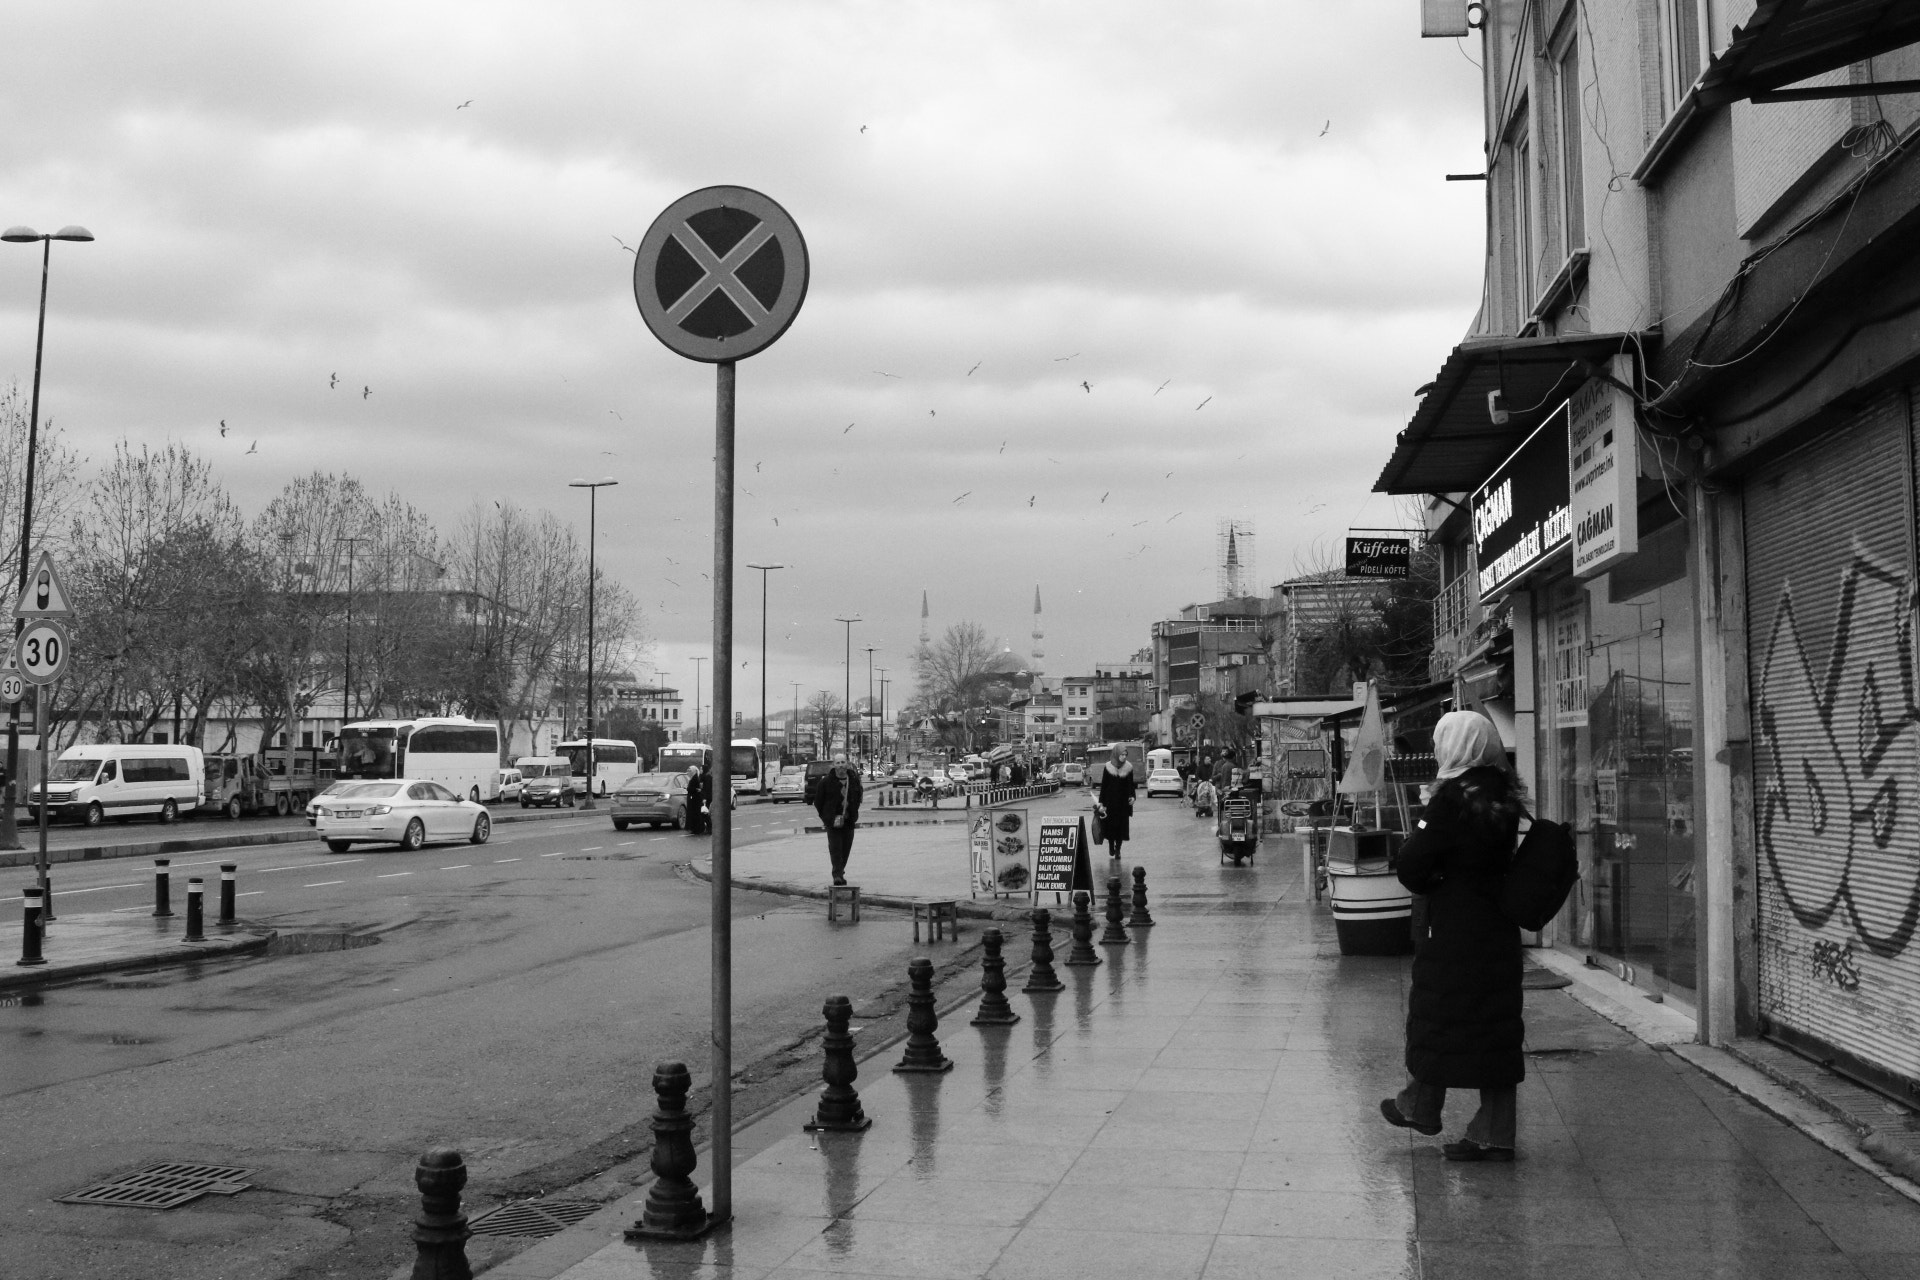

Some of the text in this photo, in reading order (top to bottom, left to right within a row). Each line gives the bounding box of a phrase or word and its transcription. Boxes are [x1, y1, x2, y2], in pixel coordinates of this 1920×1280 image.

[1595, 403, 1612, 430] Printer
[1475, 477, 1513, 554] ÇAĞMAN
[1577, 503, 1613, 553] ÇAĞMAN
[1351, 541, 1408, 558] Küffette
[1360, 564, 1406, 575] PİDELİ KÖFTE
[27, 638, 59, 666] 30
[4, 681, 20, 694] 30
[1042, 828, 1063, 836] HAMSİ
[1041, 847, 1063, 855] ÇUPRA
